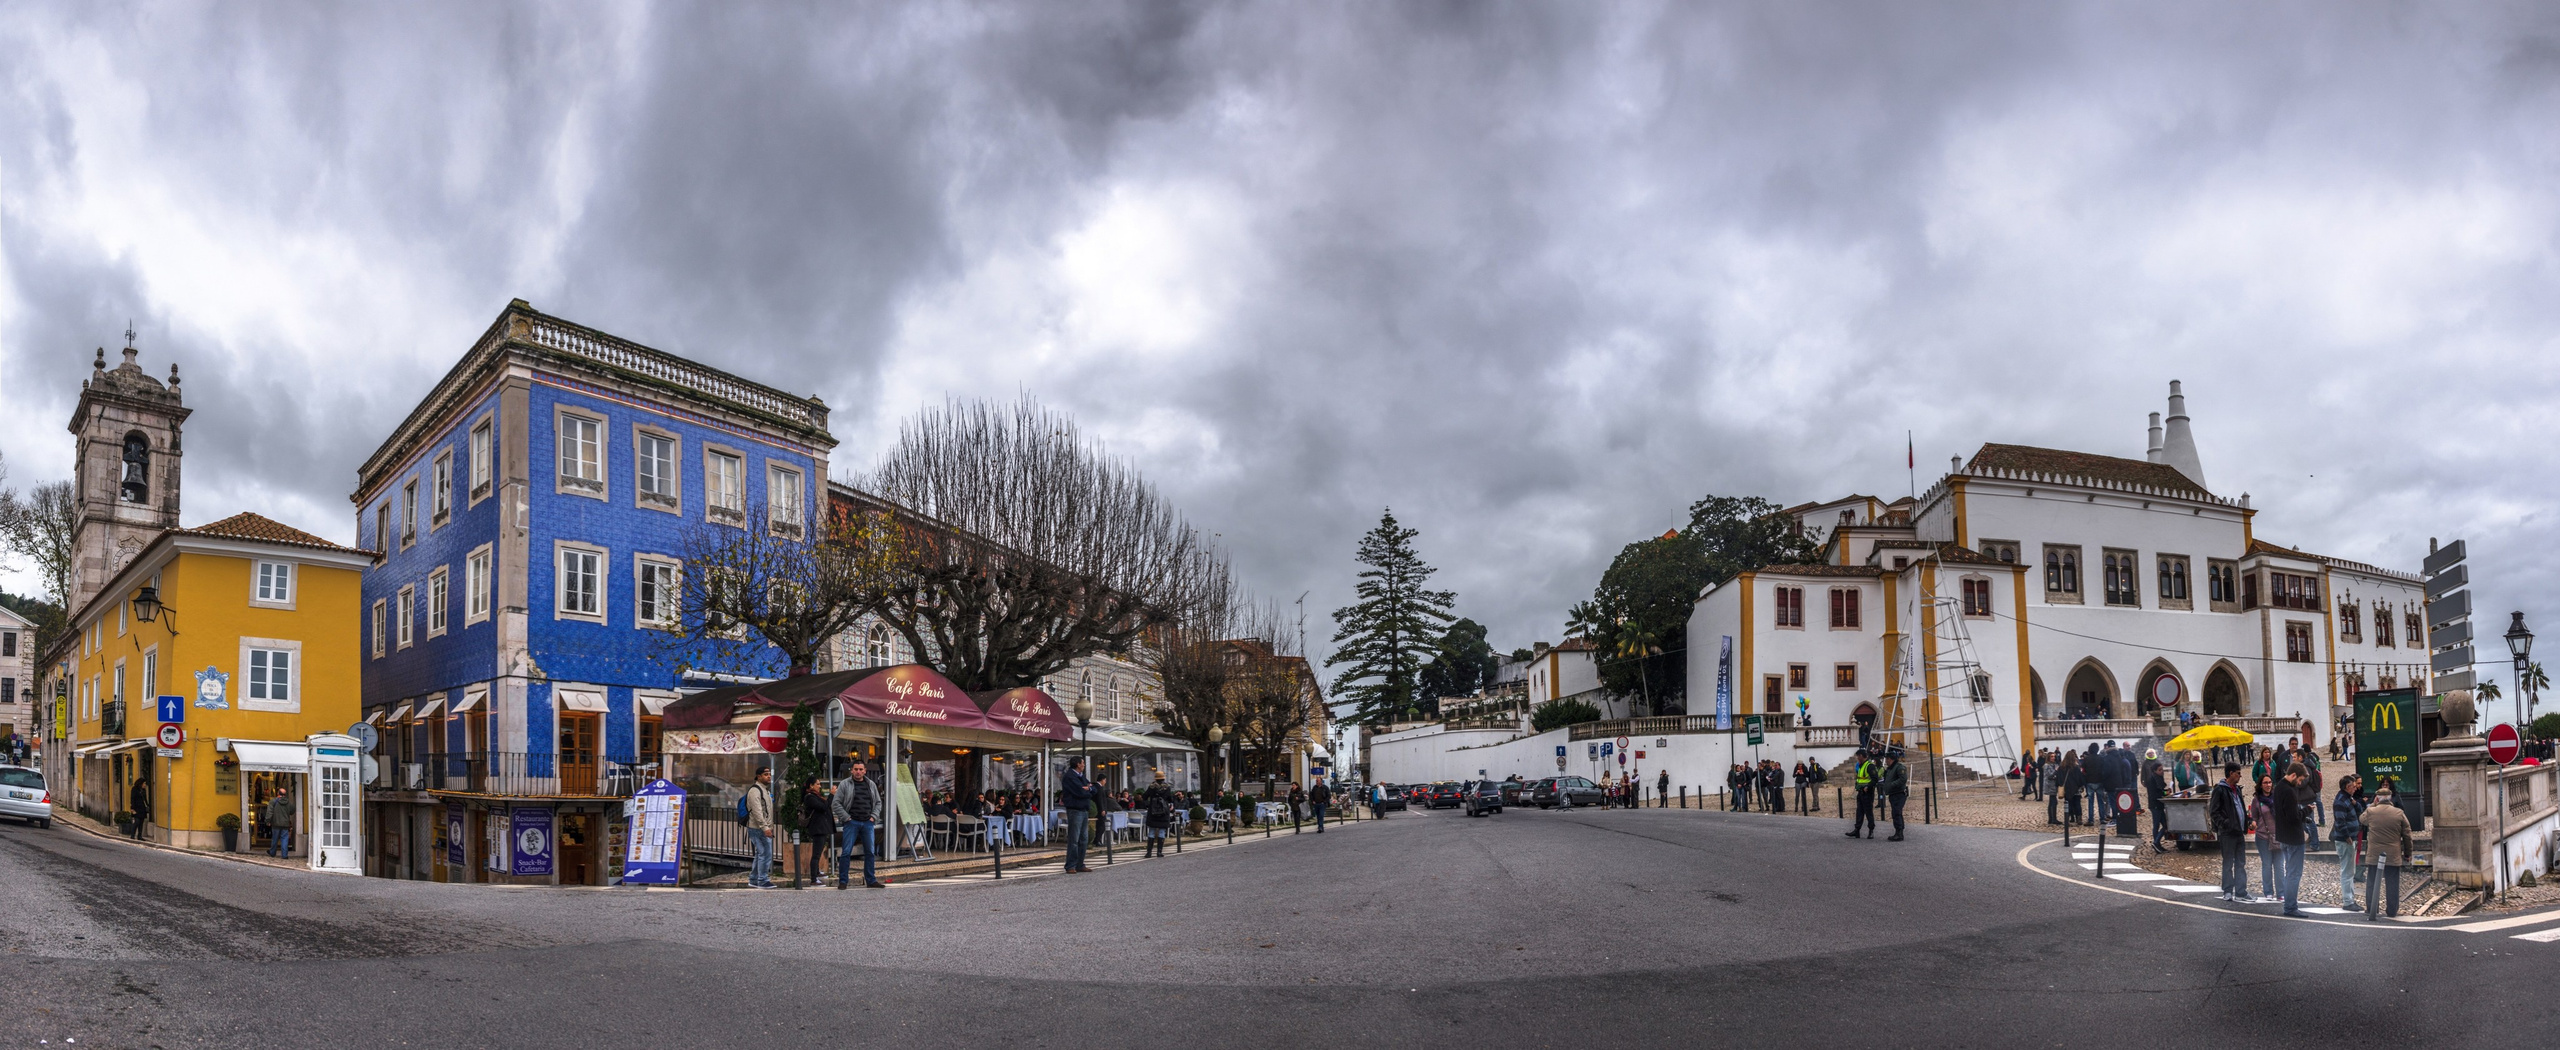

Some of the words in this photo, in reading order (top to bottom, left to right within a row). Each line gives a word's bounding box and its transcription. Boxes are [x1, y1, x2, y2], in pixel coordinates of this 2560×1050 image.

[886, 676, 913, 700] Café
[919, 682, 945, 699] Paris
[885, 701, 947, 721] Restaurante
[1011, 697, 1029, 717] Café
[1033, 702, 1051, 716] Paris
[1013, 718, 1051, 735] Cafetaria
[2373, 765, 2392, 773] Saída
[515, 815, 550, 823] Restaurante
